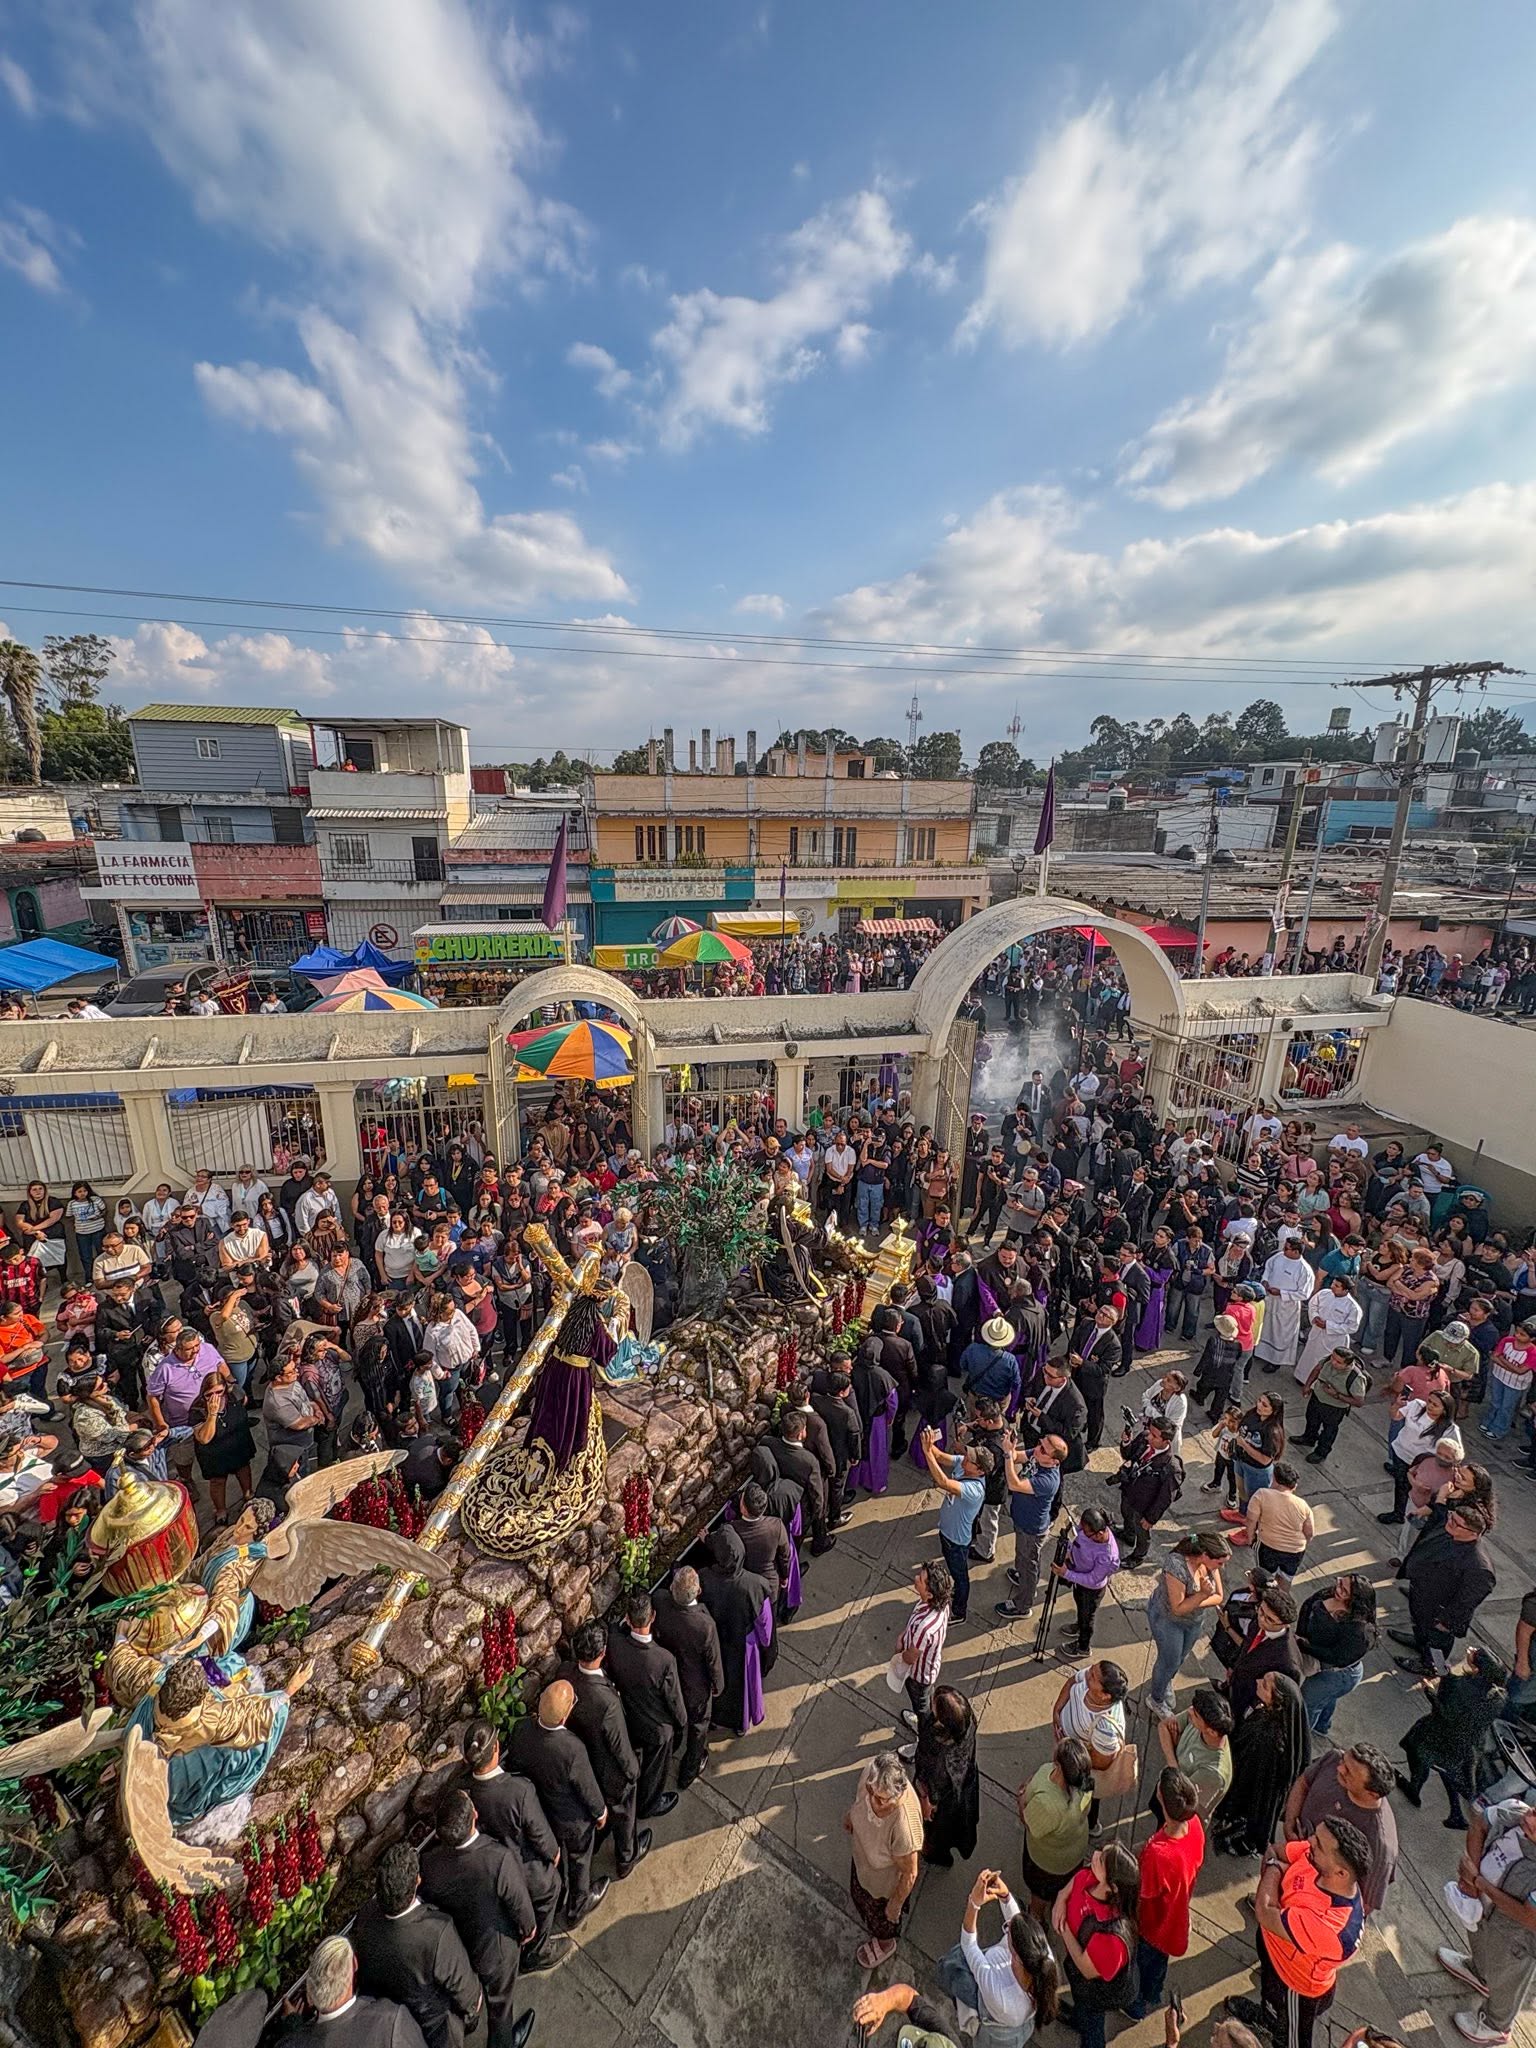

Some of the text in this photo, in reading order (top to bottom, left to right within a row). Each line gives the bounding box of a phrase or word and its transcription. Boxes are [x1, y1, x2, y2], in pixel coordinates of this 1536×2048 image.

[101, 856, 190, 868] LA FARMACIA
[103, 874, 196, 886] DE LA COLONIA
[375, 930, 390, 943] E
[432, 934, 557, 960] CHURRERIA
[622, 953, 660, 966] TIRO
